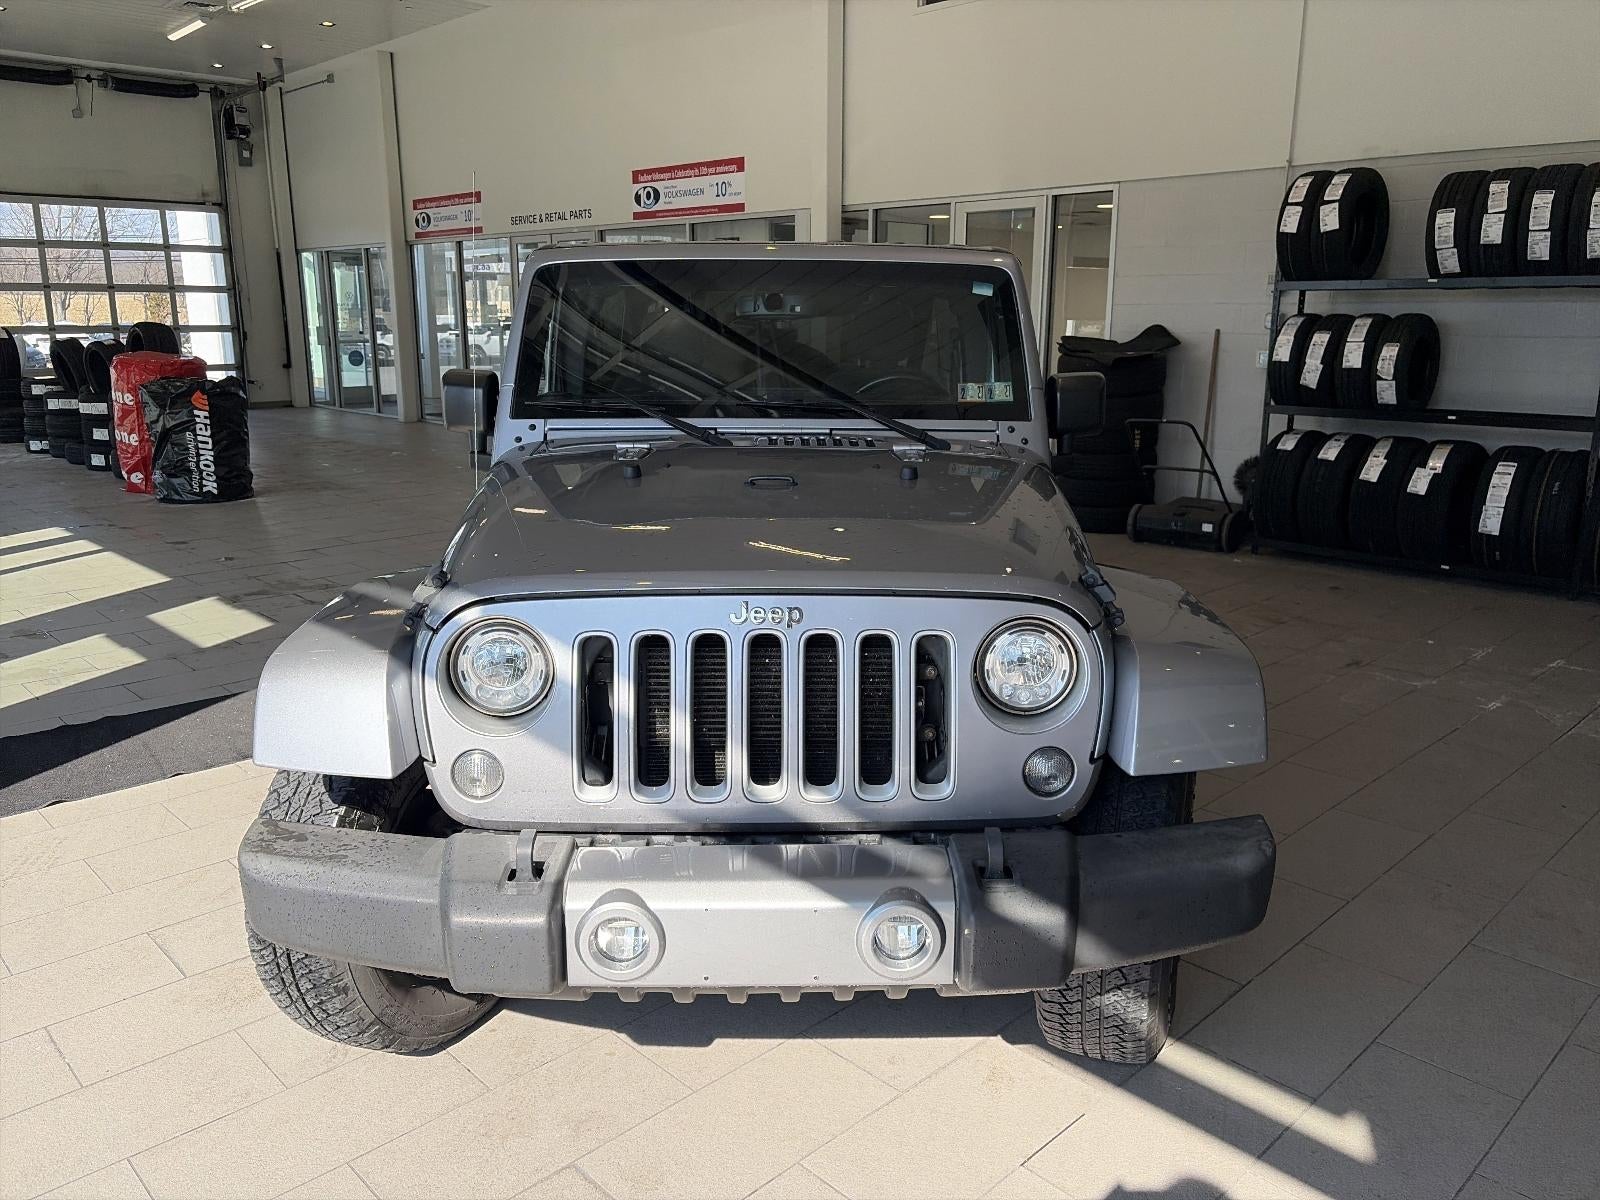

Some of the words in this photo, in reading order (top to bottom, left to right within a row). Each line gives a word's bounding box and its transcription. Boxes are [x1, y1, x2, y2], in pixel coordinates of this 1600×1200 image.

[663, 187, 705, 199] VOLKSWAGEN
[510, 214, 538, 226] SERVICE
[539, 213, 544, 223] &
[545, 211, 568, 222] RETAIL
[569, 208, 592, 220] PARTS
[729, 600, 804, 629] Jeep
